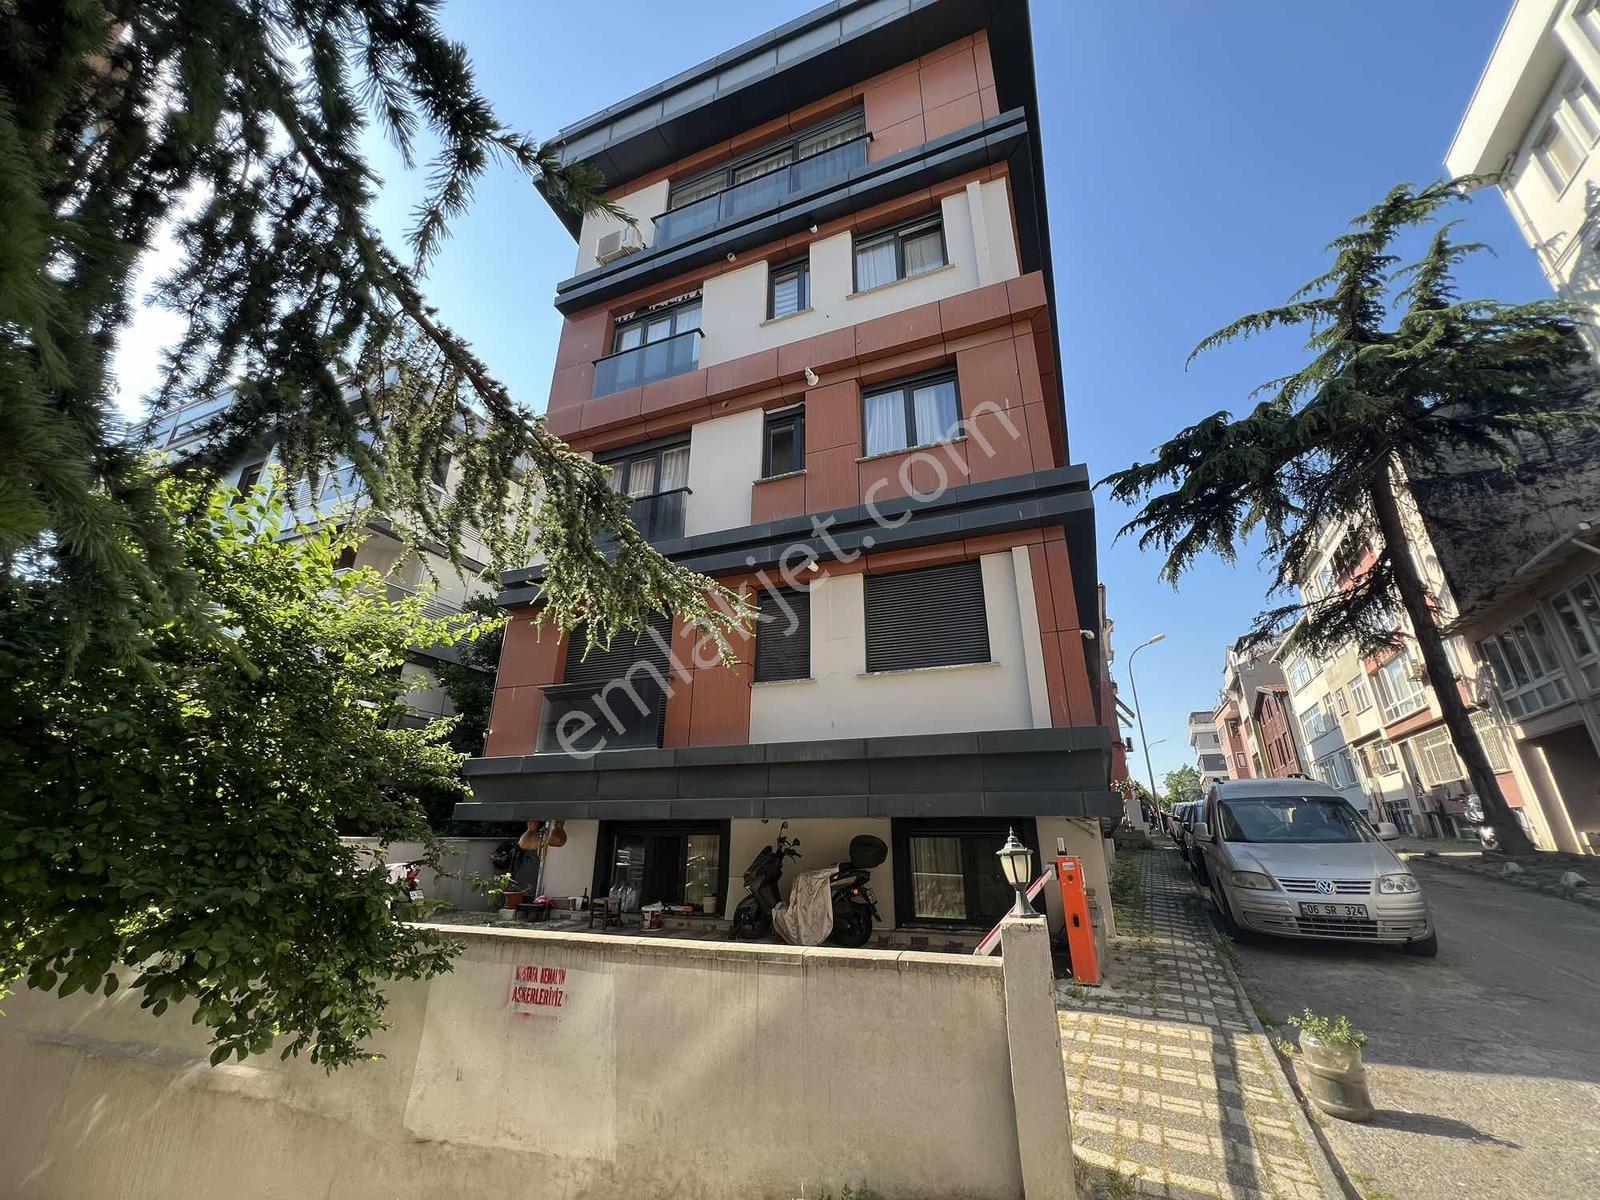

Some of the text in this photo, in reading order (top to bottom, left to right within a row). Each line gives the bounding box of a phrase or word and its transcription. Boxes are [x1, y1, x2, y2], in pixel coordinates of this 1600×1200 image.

[1307, 904, 1364, 916] 06 SR 324
